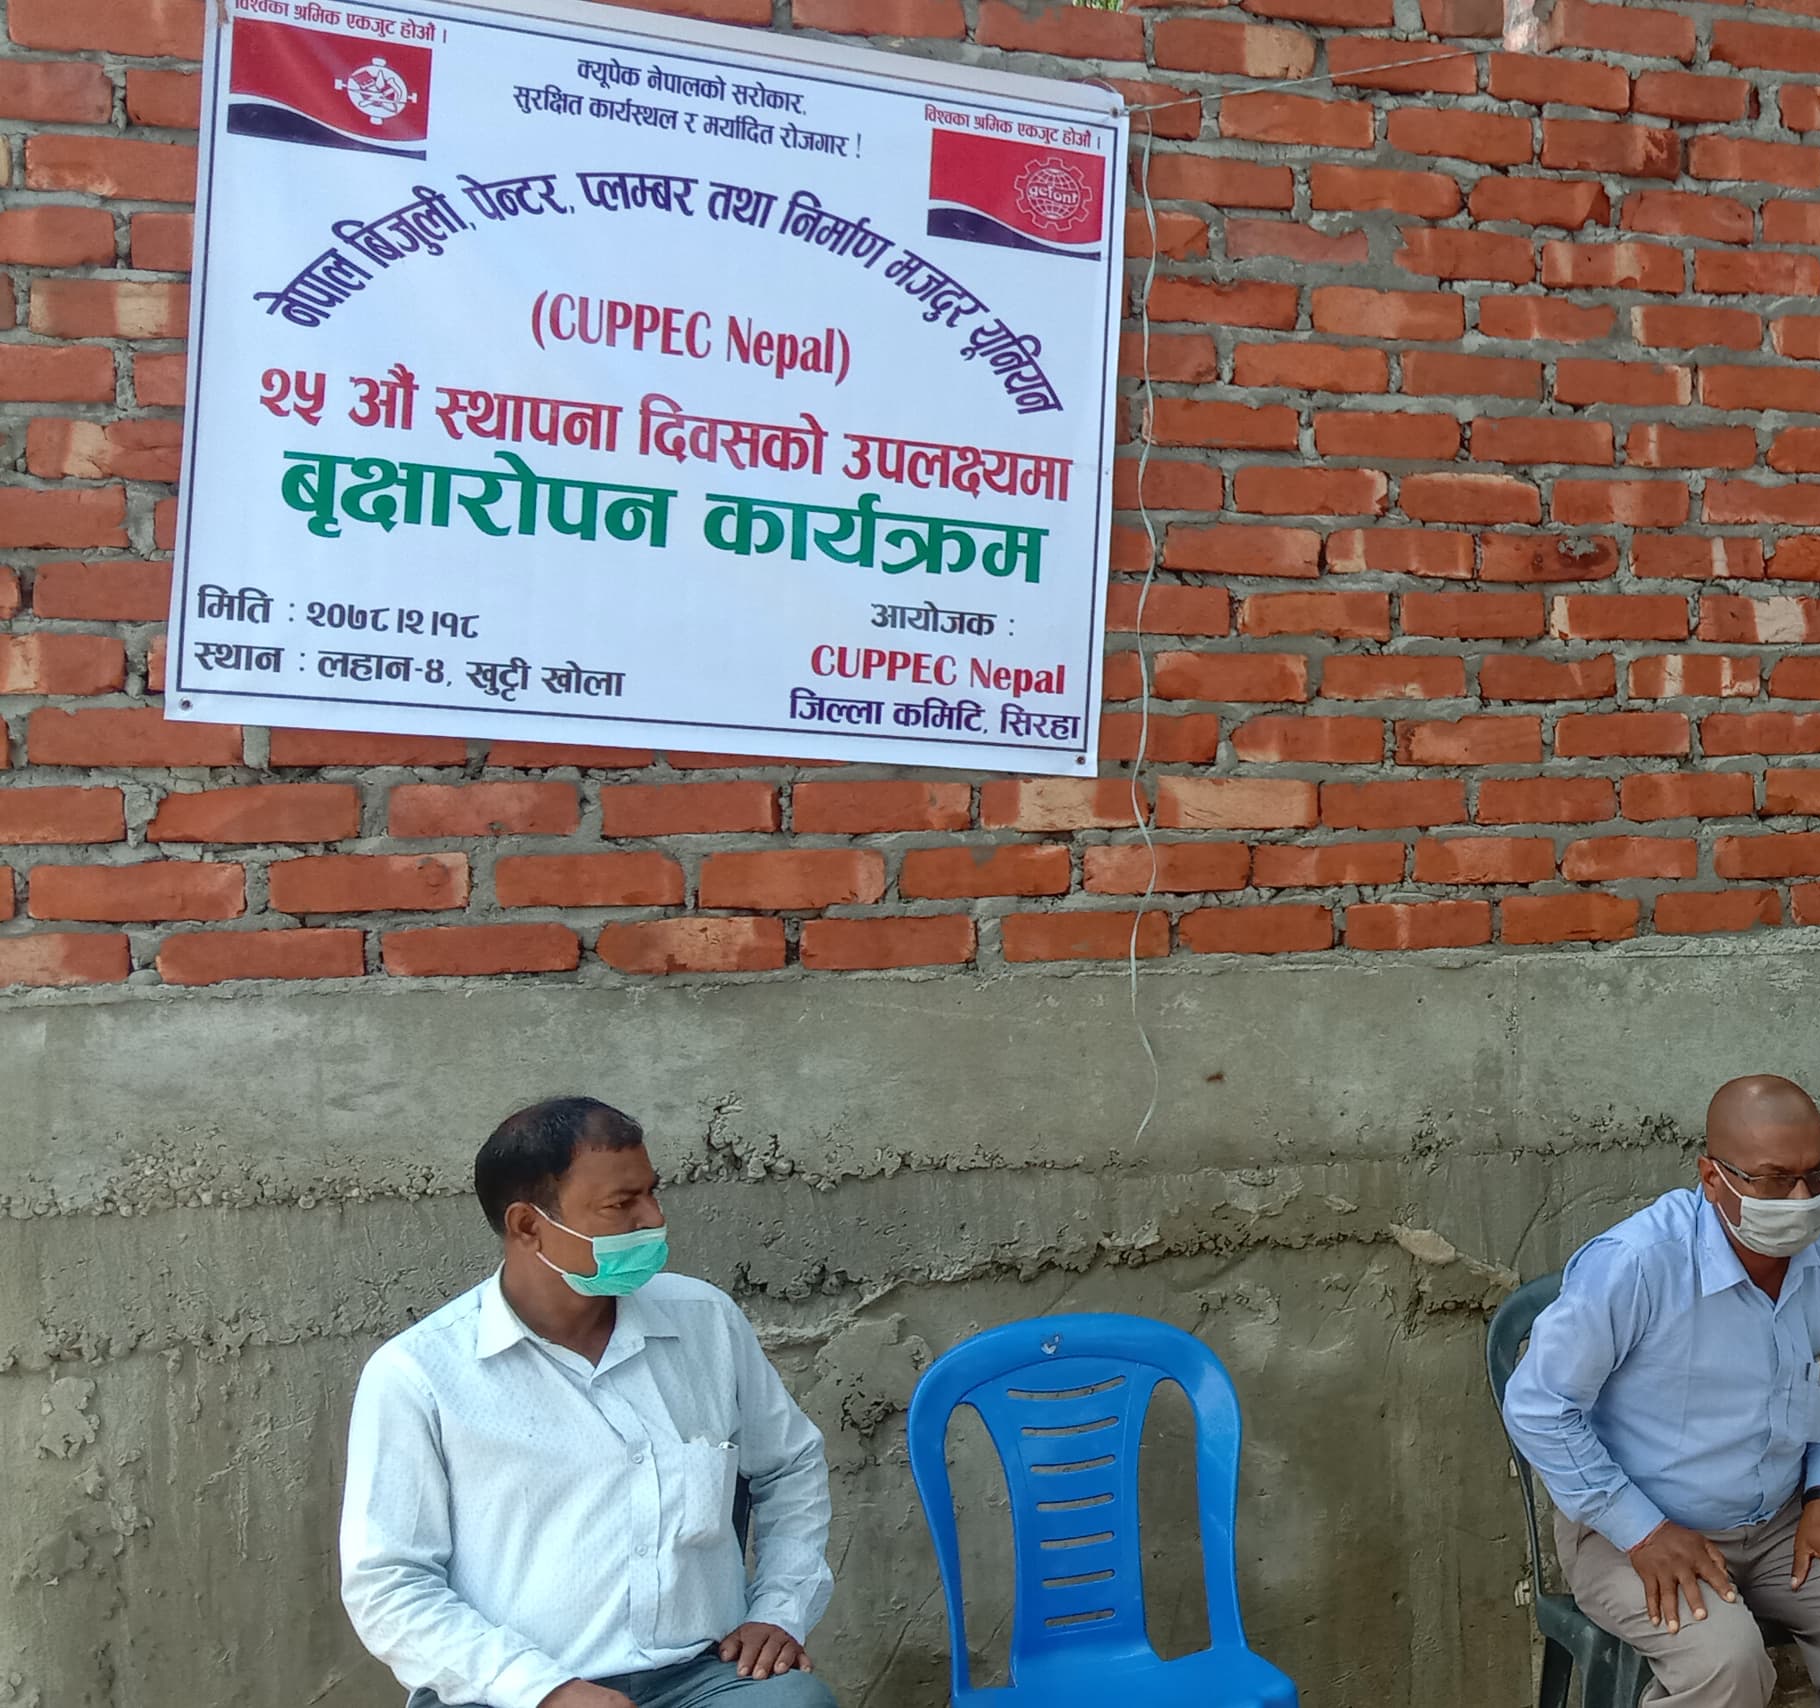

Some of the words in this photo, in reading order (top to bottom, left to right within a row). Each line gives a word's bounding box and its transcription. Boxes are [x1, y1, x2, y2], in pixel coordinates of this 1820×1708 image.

[293, 2, 341, 25] श्रमिक
[346, 12, 397, 38] एकजुट
[577, 58, 642, 88] क्यूपेक
[647, 65, 725, 101] नेपालको
[513, 84, 583, 115] सुरक्षित
[589, 97, 678, 130] कार्यस्थल
[684, 112, 698, 133] र
[703, 115, 773, 146] मर्यादित
[780, 121, 848, 158] रोजगार
[925, 103, 970, 127] विश्वका
[974, 113, 1014, 134] श्रमिक
[1018, 122, 1060, 145] एकजुट
[253, 247, 373, 329] नेपाल
[576, 172, 699, 218] प्लम्बर
[708, 182, 778, 228] तथा
[779, 191, 895, 270] निर्माण
[884, 249, 990, 328] मजदुर
[531, 290, 712, 357] (CUPPEC
[726, 314, 852, 387] Nepal)
[259, 367, 326, 426] २५
[435, 386, 623, 455] स्थापना
[639, 392, 828, 476] दिवसको
[843, 432, 1074, 502] उपलक्ष्यमा
[281, 450, 678, 548] बृक्षारोपन
[703, 492, 1050, 584] कार्यक्रम
[197, 584, 274, 624] मिति
[870, 601, 997, 637] आयोजक
[194, 642, 285, 673] स्थान
[465, 656, 531, 702] खुट्टी
[541, 661, 626, 697] खोला
[810, 644, 957, 686] CUPPEC
[969, 656, 1067, 698] Nepal
[789, 688, 885, 726] जिल्ला
[1000, 703, 1081, 741] सिरहा
